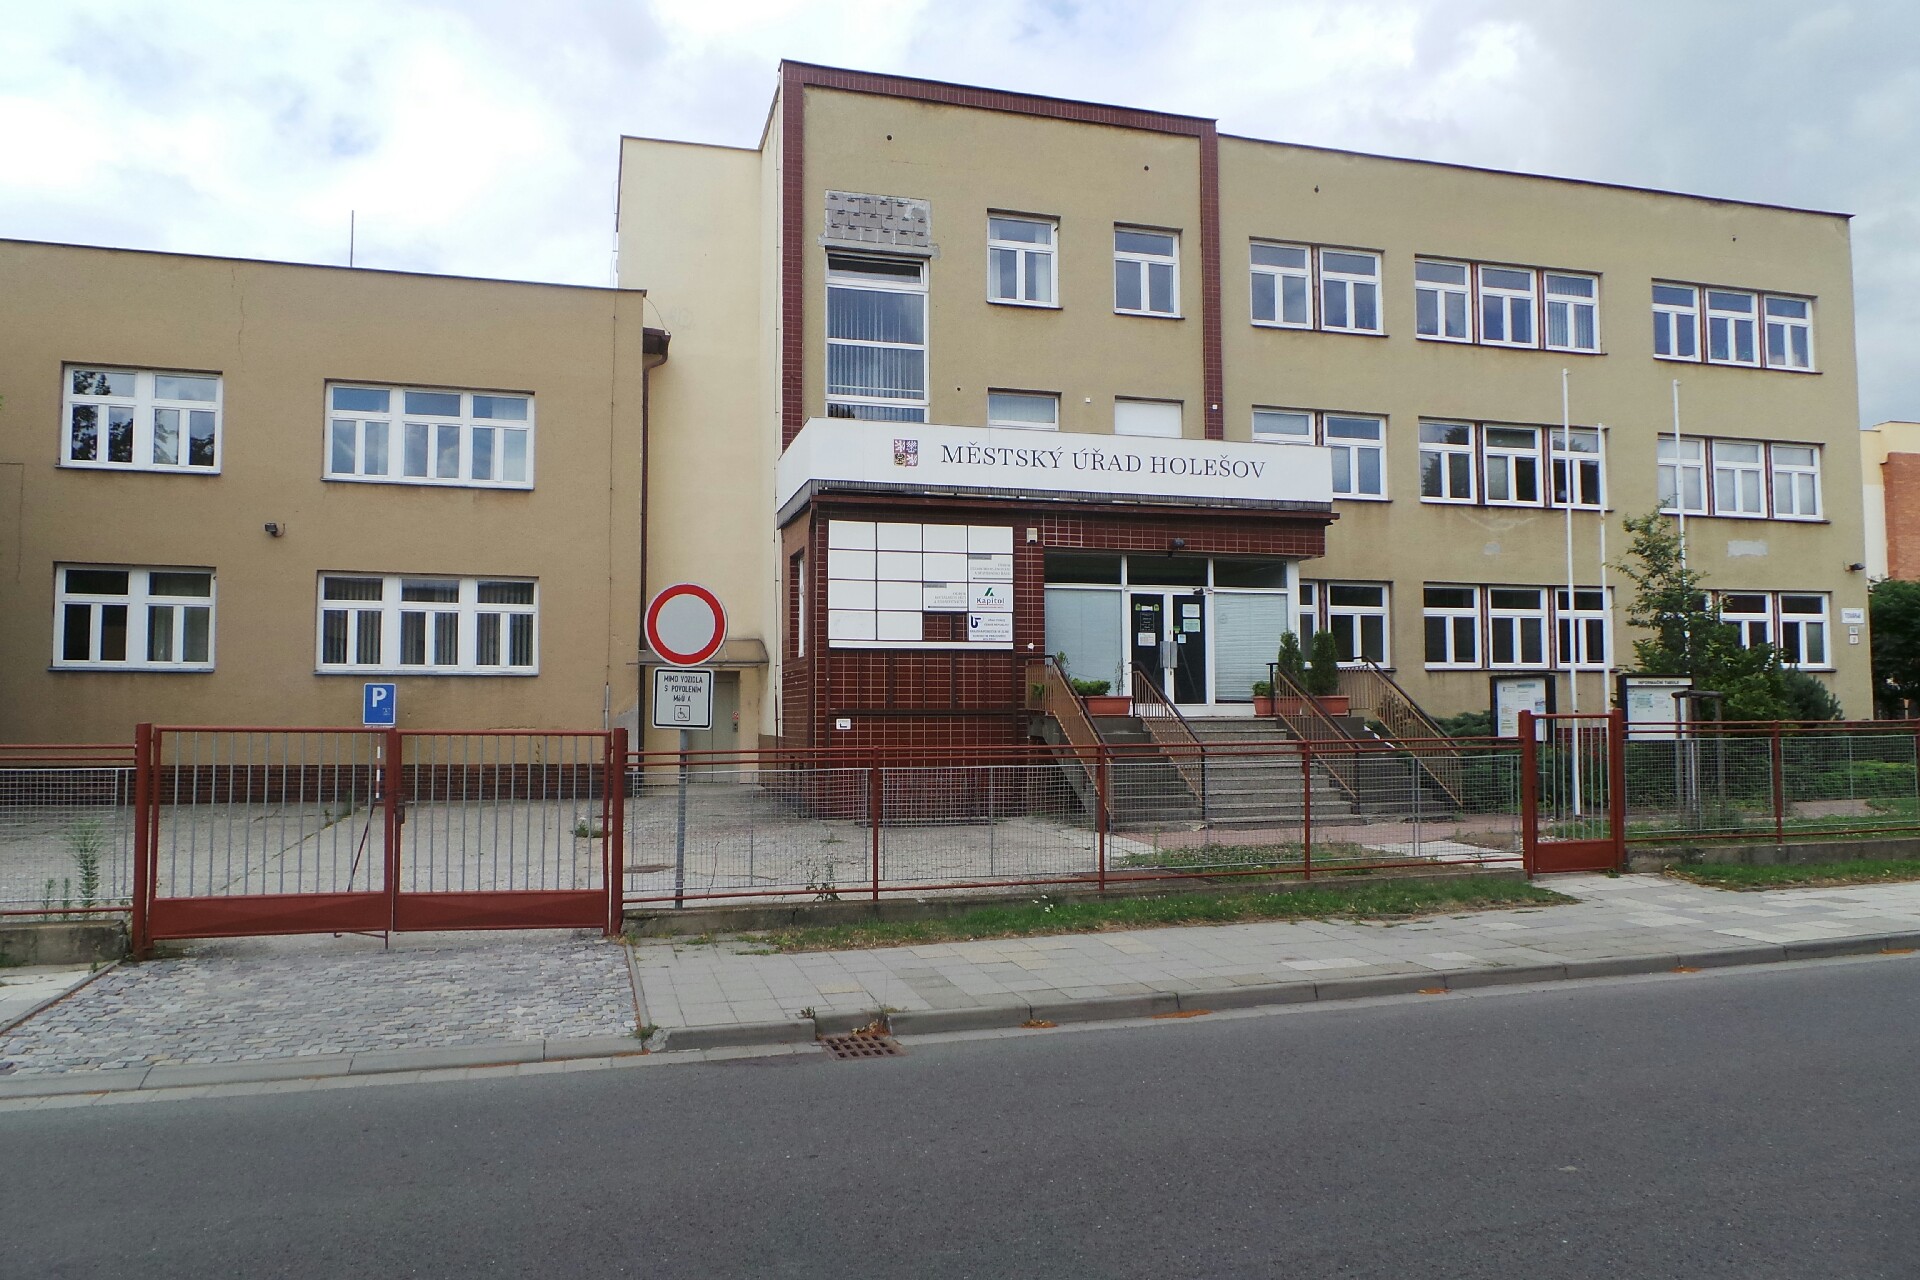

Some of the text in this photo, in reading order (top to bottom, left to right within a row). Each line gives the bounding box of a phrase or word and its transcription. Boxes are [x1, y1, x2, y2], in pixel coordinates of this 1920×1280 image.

[941, 441, 1266, 478] MĚSTSKÝ ÚŘAD HOLEŠOV
[976, 597, 1004, 605] Kapitol
[664, 675, 703, 683] MIMO VOZIDLA
[664, 684, 702, 693] S POVOLENÍM
[372, 687, 387, 708] P
